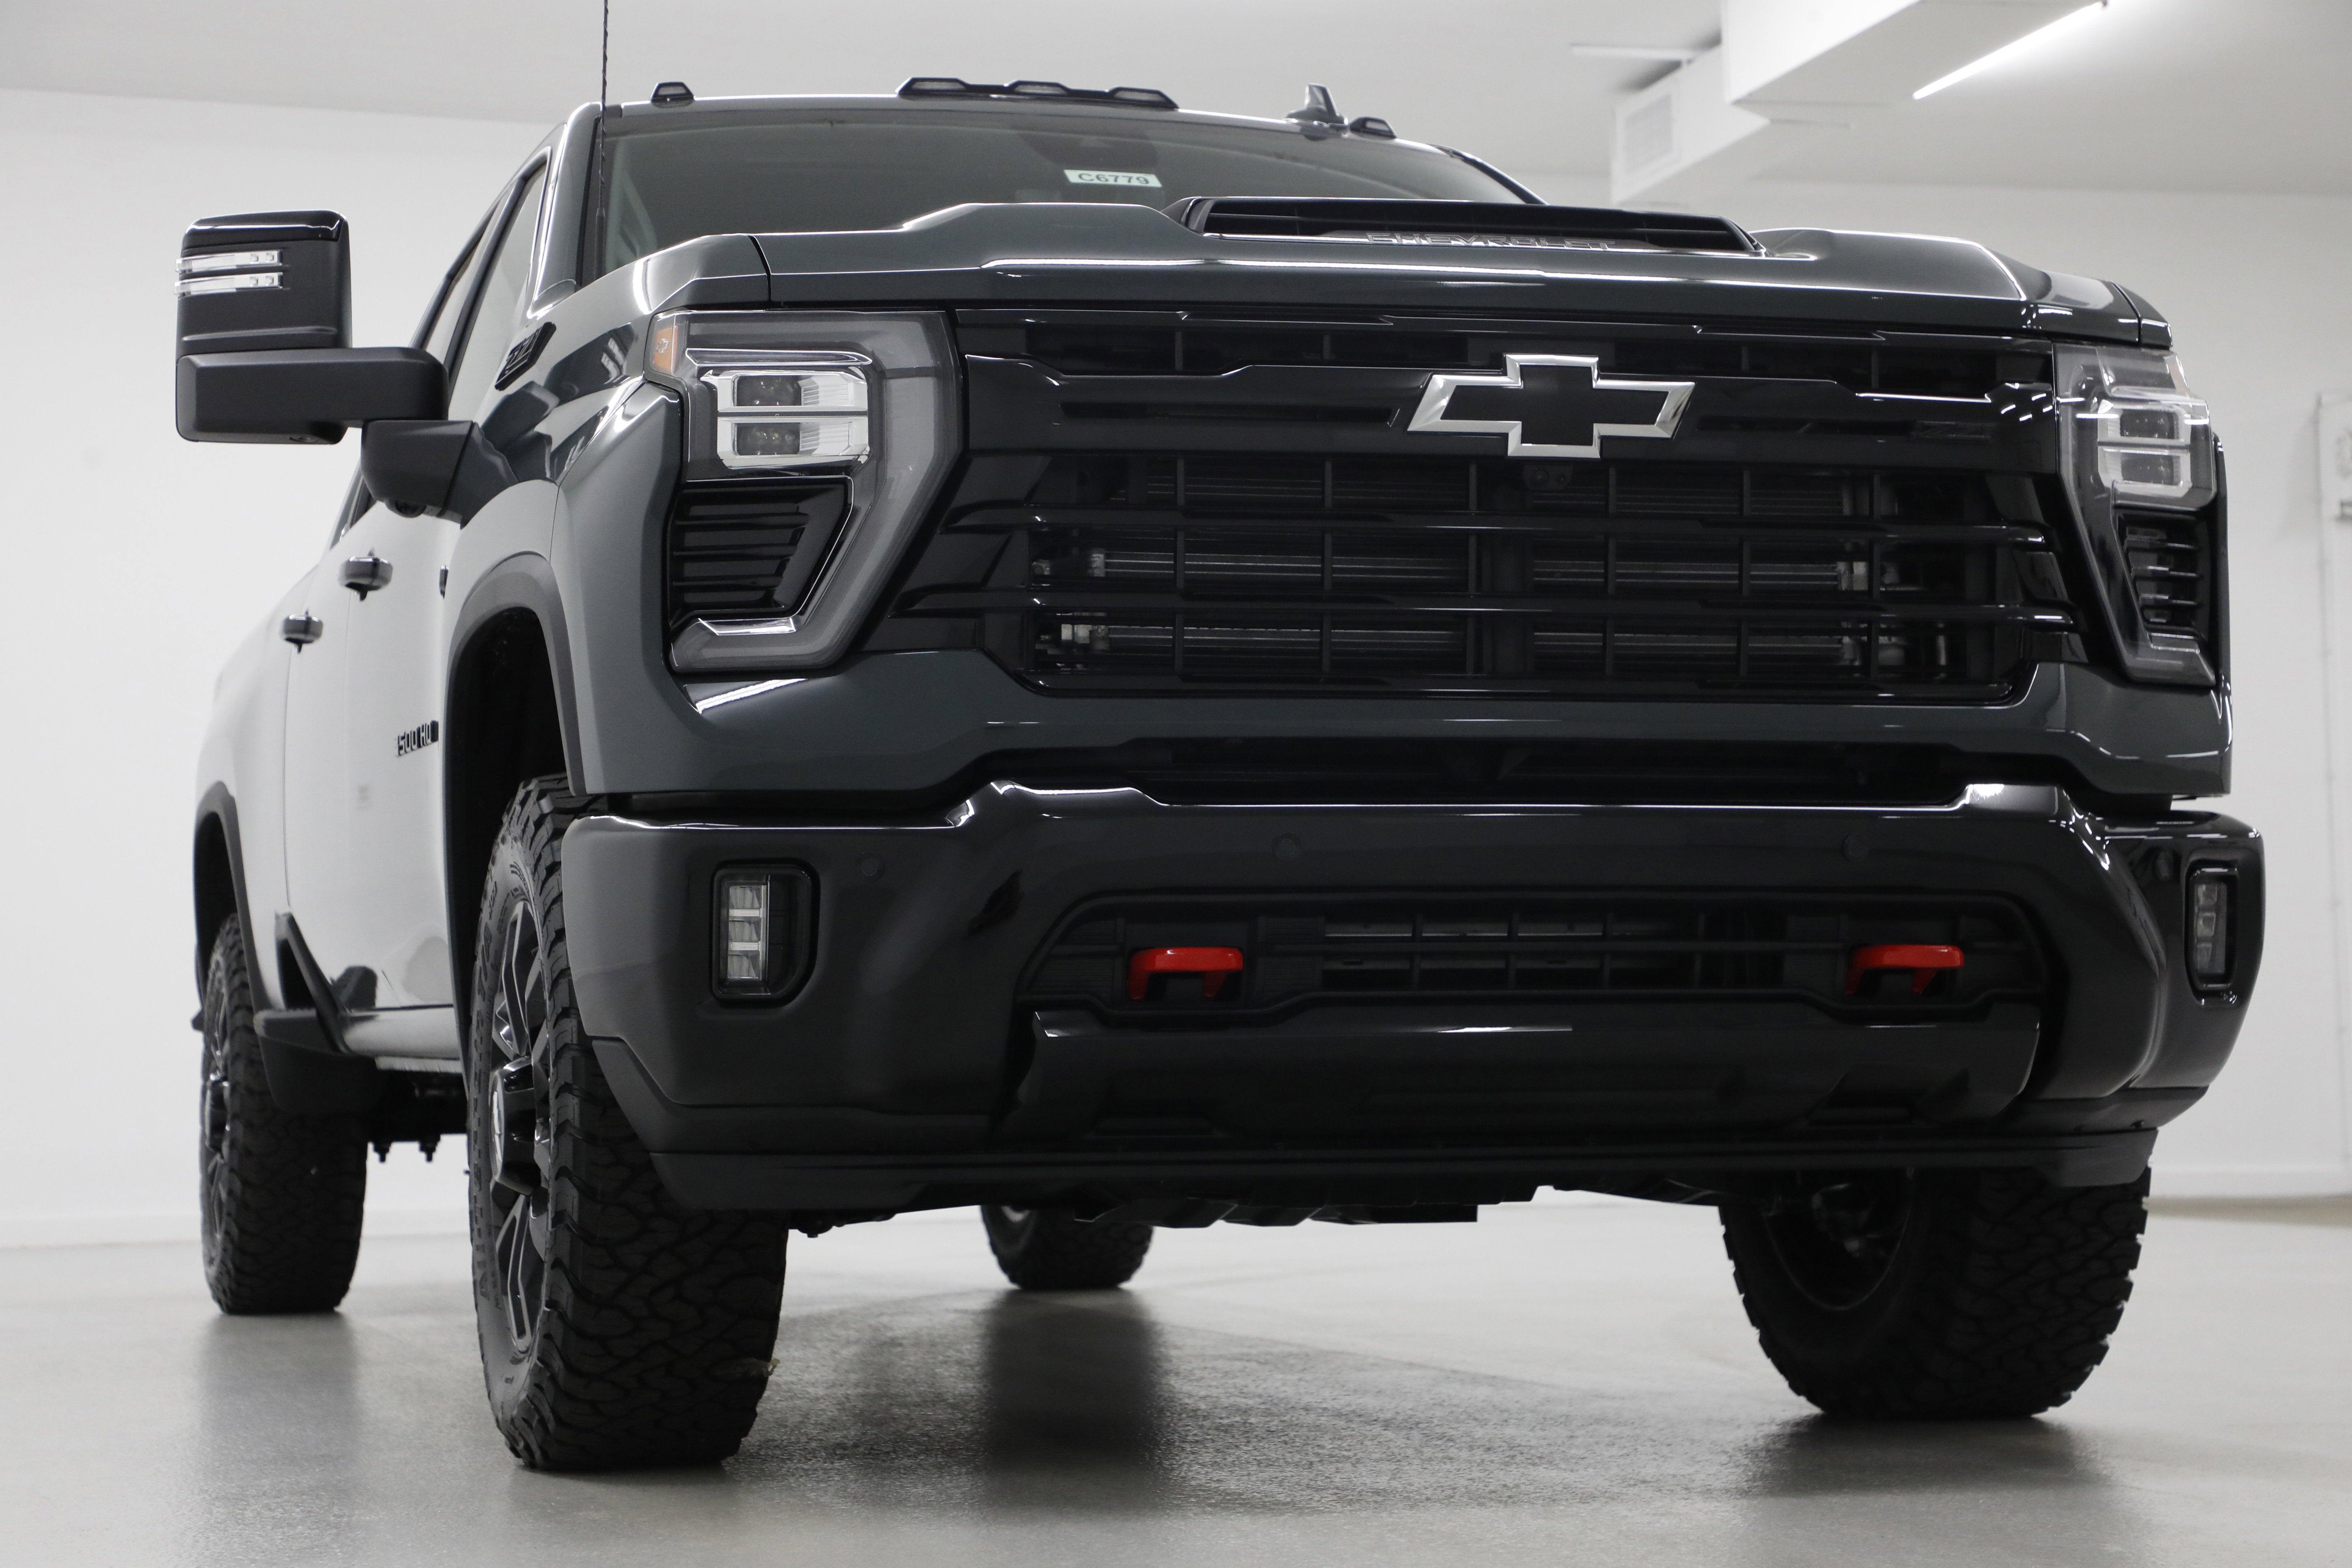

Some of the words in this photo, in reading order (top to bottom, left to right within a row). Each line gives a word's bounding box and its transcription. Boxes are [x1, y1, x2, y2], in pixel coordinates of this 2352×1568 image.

[1078, 173, 1149, 184] C6779
[1366, 232, 1616, 251] CHEVROLET
[394, 726, 420, 756] 500
